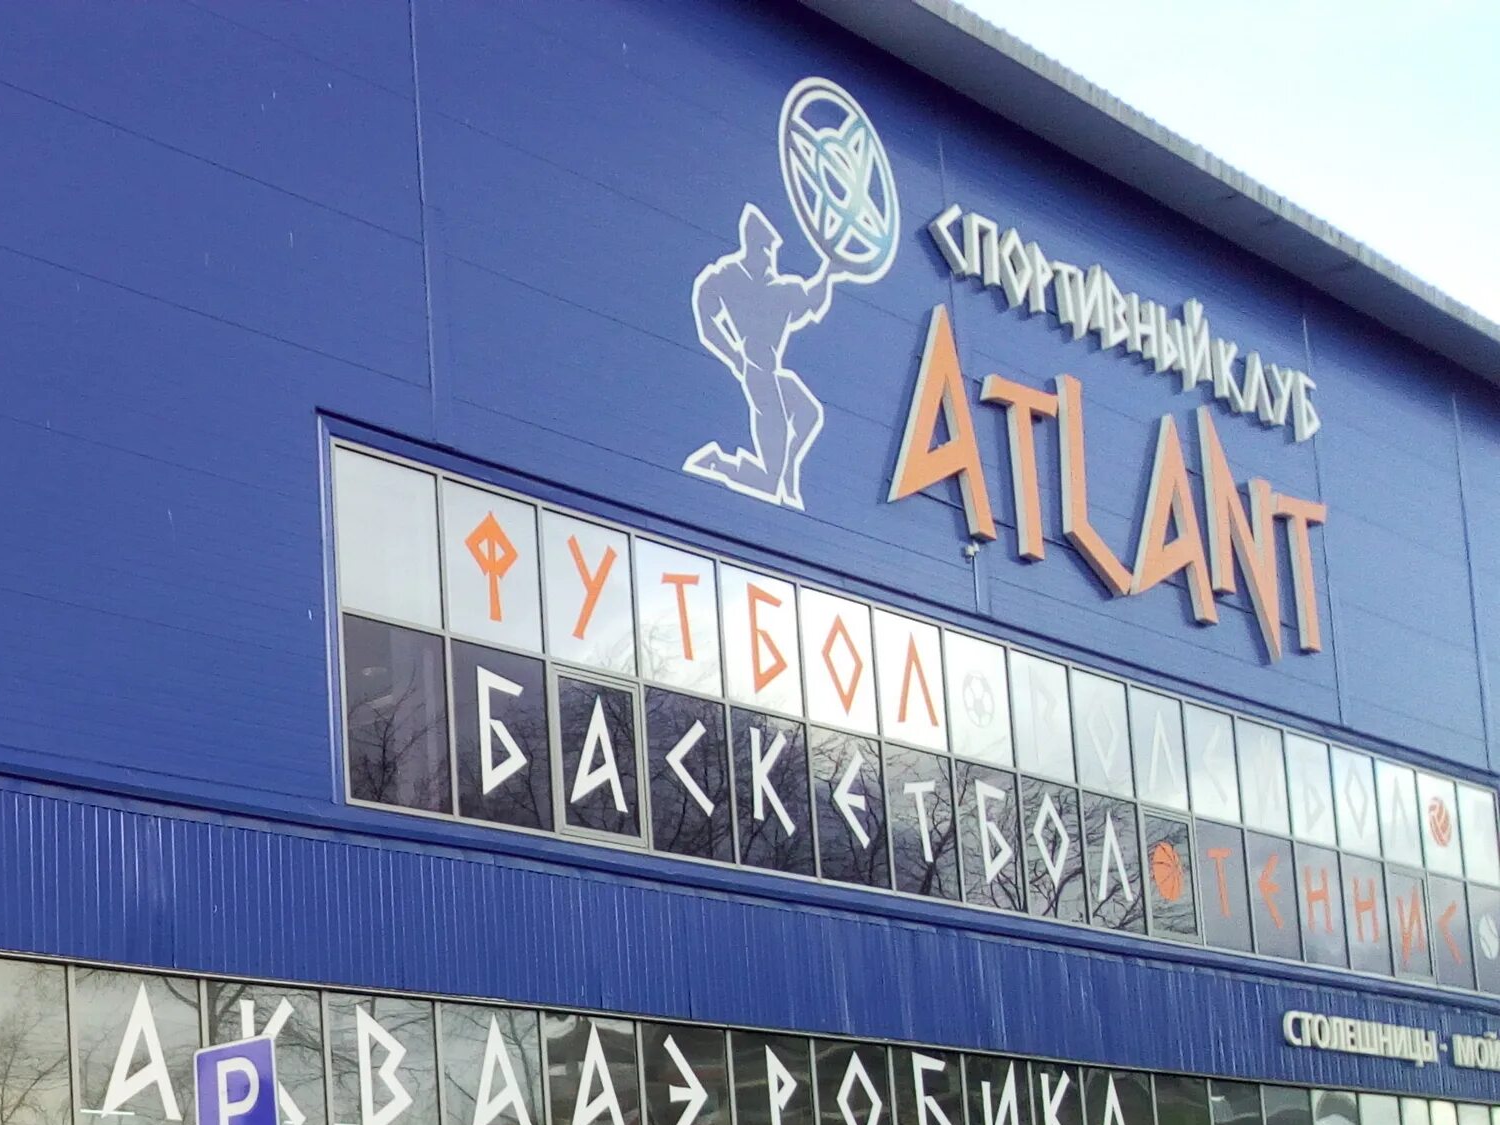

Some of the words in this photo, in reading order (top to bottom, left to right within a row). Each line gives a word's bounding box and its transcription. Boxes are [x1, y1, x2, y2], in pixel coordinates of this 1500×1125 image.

[927, 203, 1214, 392] СПОРТИВНЫЙ
[1210, 336, 1322, 442] КЛУБ
[886, 303, 1327, 664] ATLANT
[464, 510, 940, 728] ФУТБОЛ
[475, 665, 1134, 902] БАСКЕТБОЛ
[1206, 847, 1464, 967] ТЕННИС
[1282, 1008, 1438, 1069] СТОЛЕШНИЦЫ
